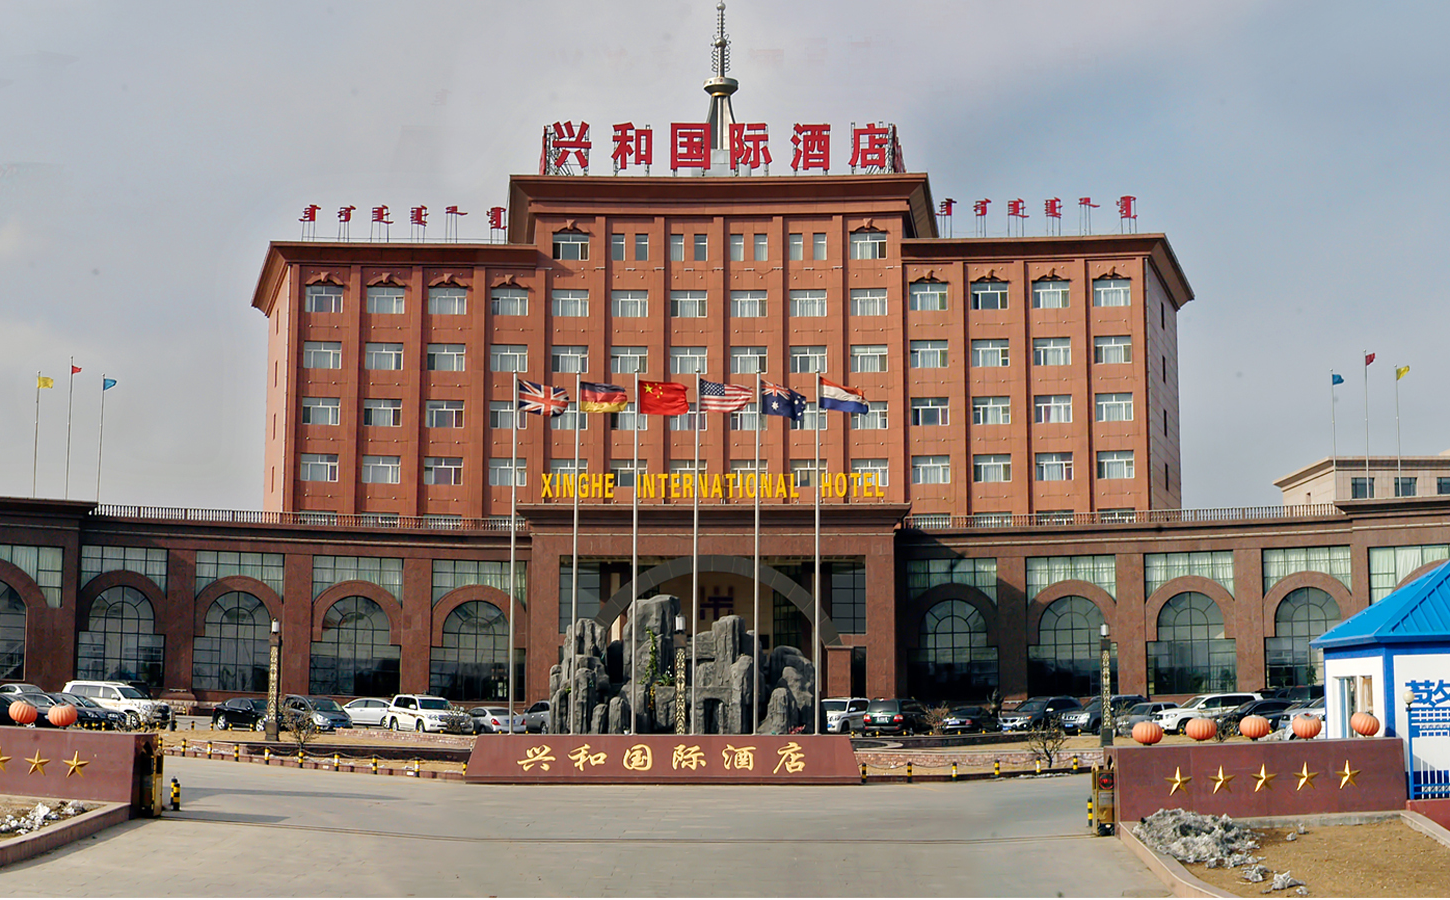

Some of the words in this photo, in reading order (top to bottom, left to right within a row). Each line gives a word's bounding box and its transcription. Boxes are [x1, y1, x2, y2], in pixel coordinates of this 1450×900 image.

[552, 121, 889, 170] 兴和国际酒店
[541, 472, 615, 499] XINGHE
[636, 472, 800, 499] INTERNATIONAL
[821, 472, 885, 498] HOTEL
[516, 741, 807, 775] 兴和国际酒店
